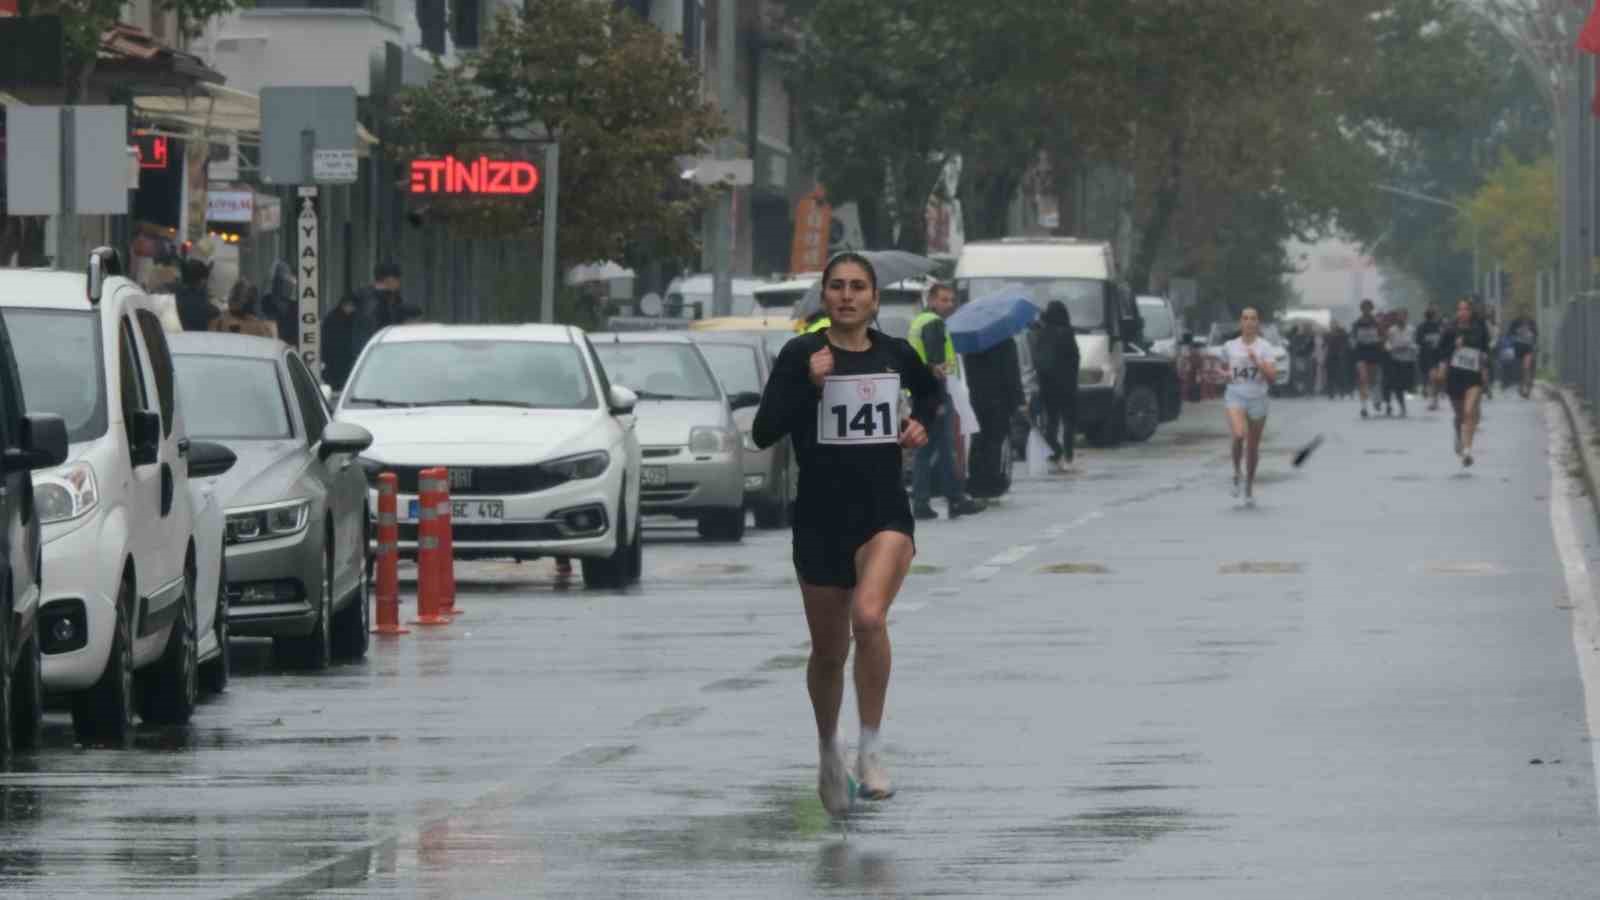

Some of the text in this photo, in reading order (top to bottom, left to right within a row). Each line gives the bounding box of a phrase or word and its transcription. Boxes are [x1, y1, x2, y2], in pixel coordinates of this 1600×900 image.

[302, 225, 316, 299] YAYA
[1233, 367, 1259, 381] 147
[831, 402, 892, 437] 141
[478, 503, 501, 519] 412
